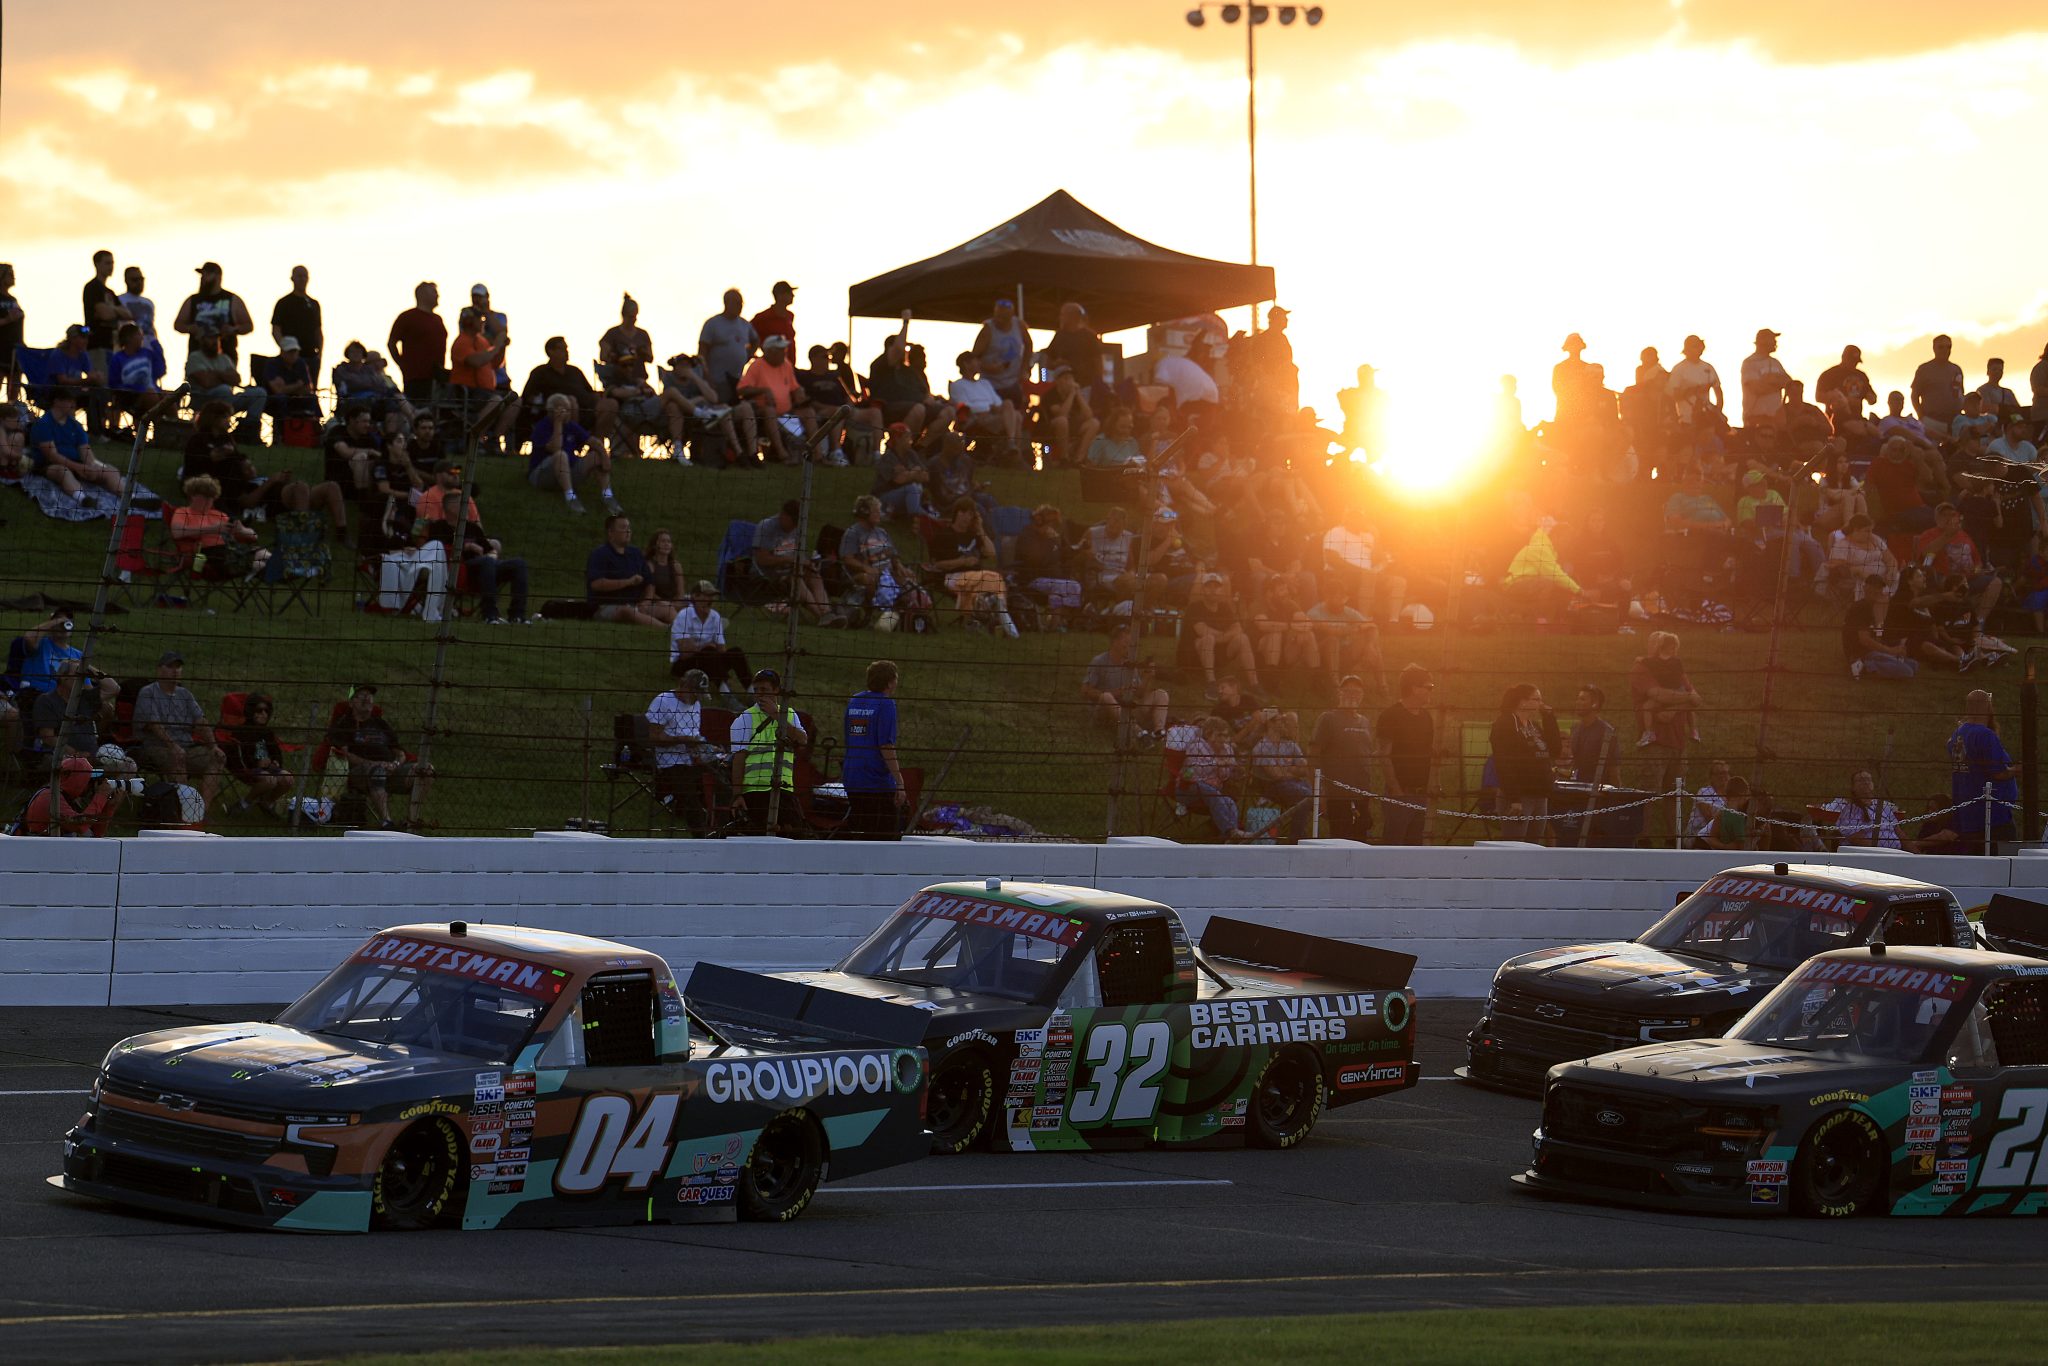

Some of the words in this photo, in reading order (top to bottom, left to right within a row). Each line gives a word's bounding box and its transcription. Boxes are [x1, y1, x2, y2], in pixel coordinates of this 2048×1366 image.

[1704, 878, 1856, 915] CRAFTSMAN
[906, 893, 1070, 939] CRAFTSMAN
[360, 936, 546, 989] CRAFTSMAN
[1802, 961, 1952, 994] RAFTSMAN
[1189, 1000, 1270, 1026] BEST
[1277, 993, 1378, 1019] VALUE
[946, 1028, 999, 1048] GOODYEAR
[1016, 1030, 1042, 1041] SKF
[1191, 1018, 1348, 1050] CARRIERS
[1044, 1049, 1072, 1059] COMETIC
[1325, 1042, 1338, 1055] On
[1339, 1041, 1367, 1055] target.
[1368, 1040, 1380, 1051] On
[1381, 1038, 1402, 1050] time.
[705, 1053, 892, 1104] GROUP1001
[1069, 1021, 1171, 1123] 32
[505, 1081, 535, 1090] CRAFTSMAN
[1008, 1083, 1036, 1093] JESEL
[1909, 1086, 1941, 1098] SKF
[475, 1088, 503, 1102] SKF
[1809, 1089, 1870, 1107] GOODYEAR
[1942, 1091, 1972, 1099] CRAFTSMAN
[400, 1099, 461, 1120] GOODYEAR
[469, 1102, 501, 1116] JESEL
[504, 1099, 536, 1111] COMETIC
[1034, 1106, 1061, 1115] tilton
[1280, 1073, 1324, 1148] GOODYEAR
[1942, 1107, 1972, 1117] COMETIC
[507, 1112, 531, 1120] LINCOLN
[1600, 1111, 1620, 1125] Ford
[1813, 1109, 1879, 1146] GOODYEAR
[558, 1094, 680, 1191] 04
[1976, 1088, 2048, 1187] 2
[1906, 1141, 1937, 1152] JESEL
[498, 1150, 529, 1160] tilton
[432, 1117, 459, 1216] GOODYEAR
[1749, 1161, 1785, 1172] SIMPSON
[1937, 1161, 1967, 1170] tilton
[1747, 1173, 1788, 1183] ARP
[488, 1181, 511, 1193] Holley
[1931, 1183, 1954, 1195] Holley
[677, 1185, 736, 1205] CARQUEST
[779, 1187, 812, 1222] EAGLE
[1819, 1200, 1857, 1217] EAGLE
